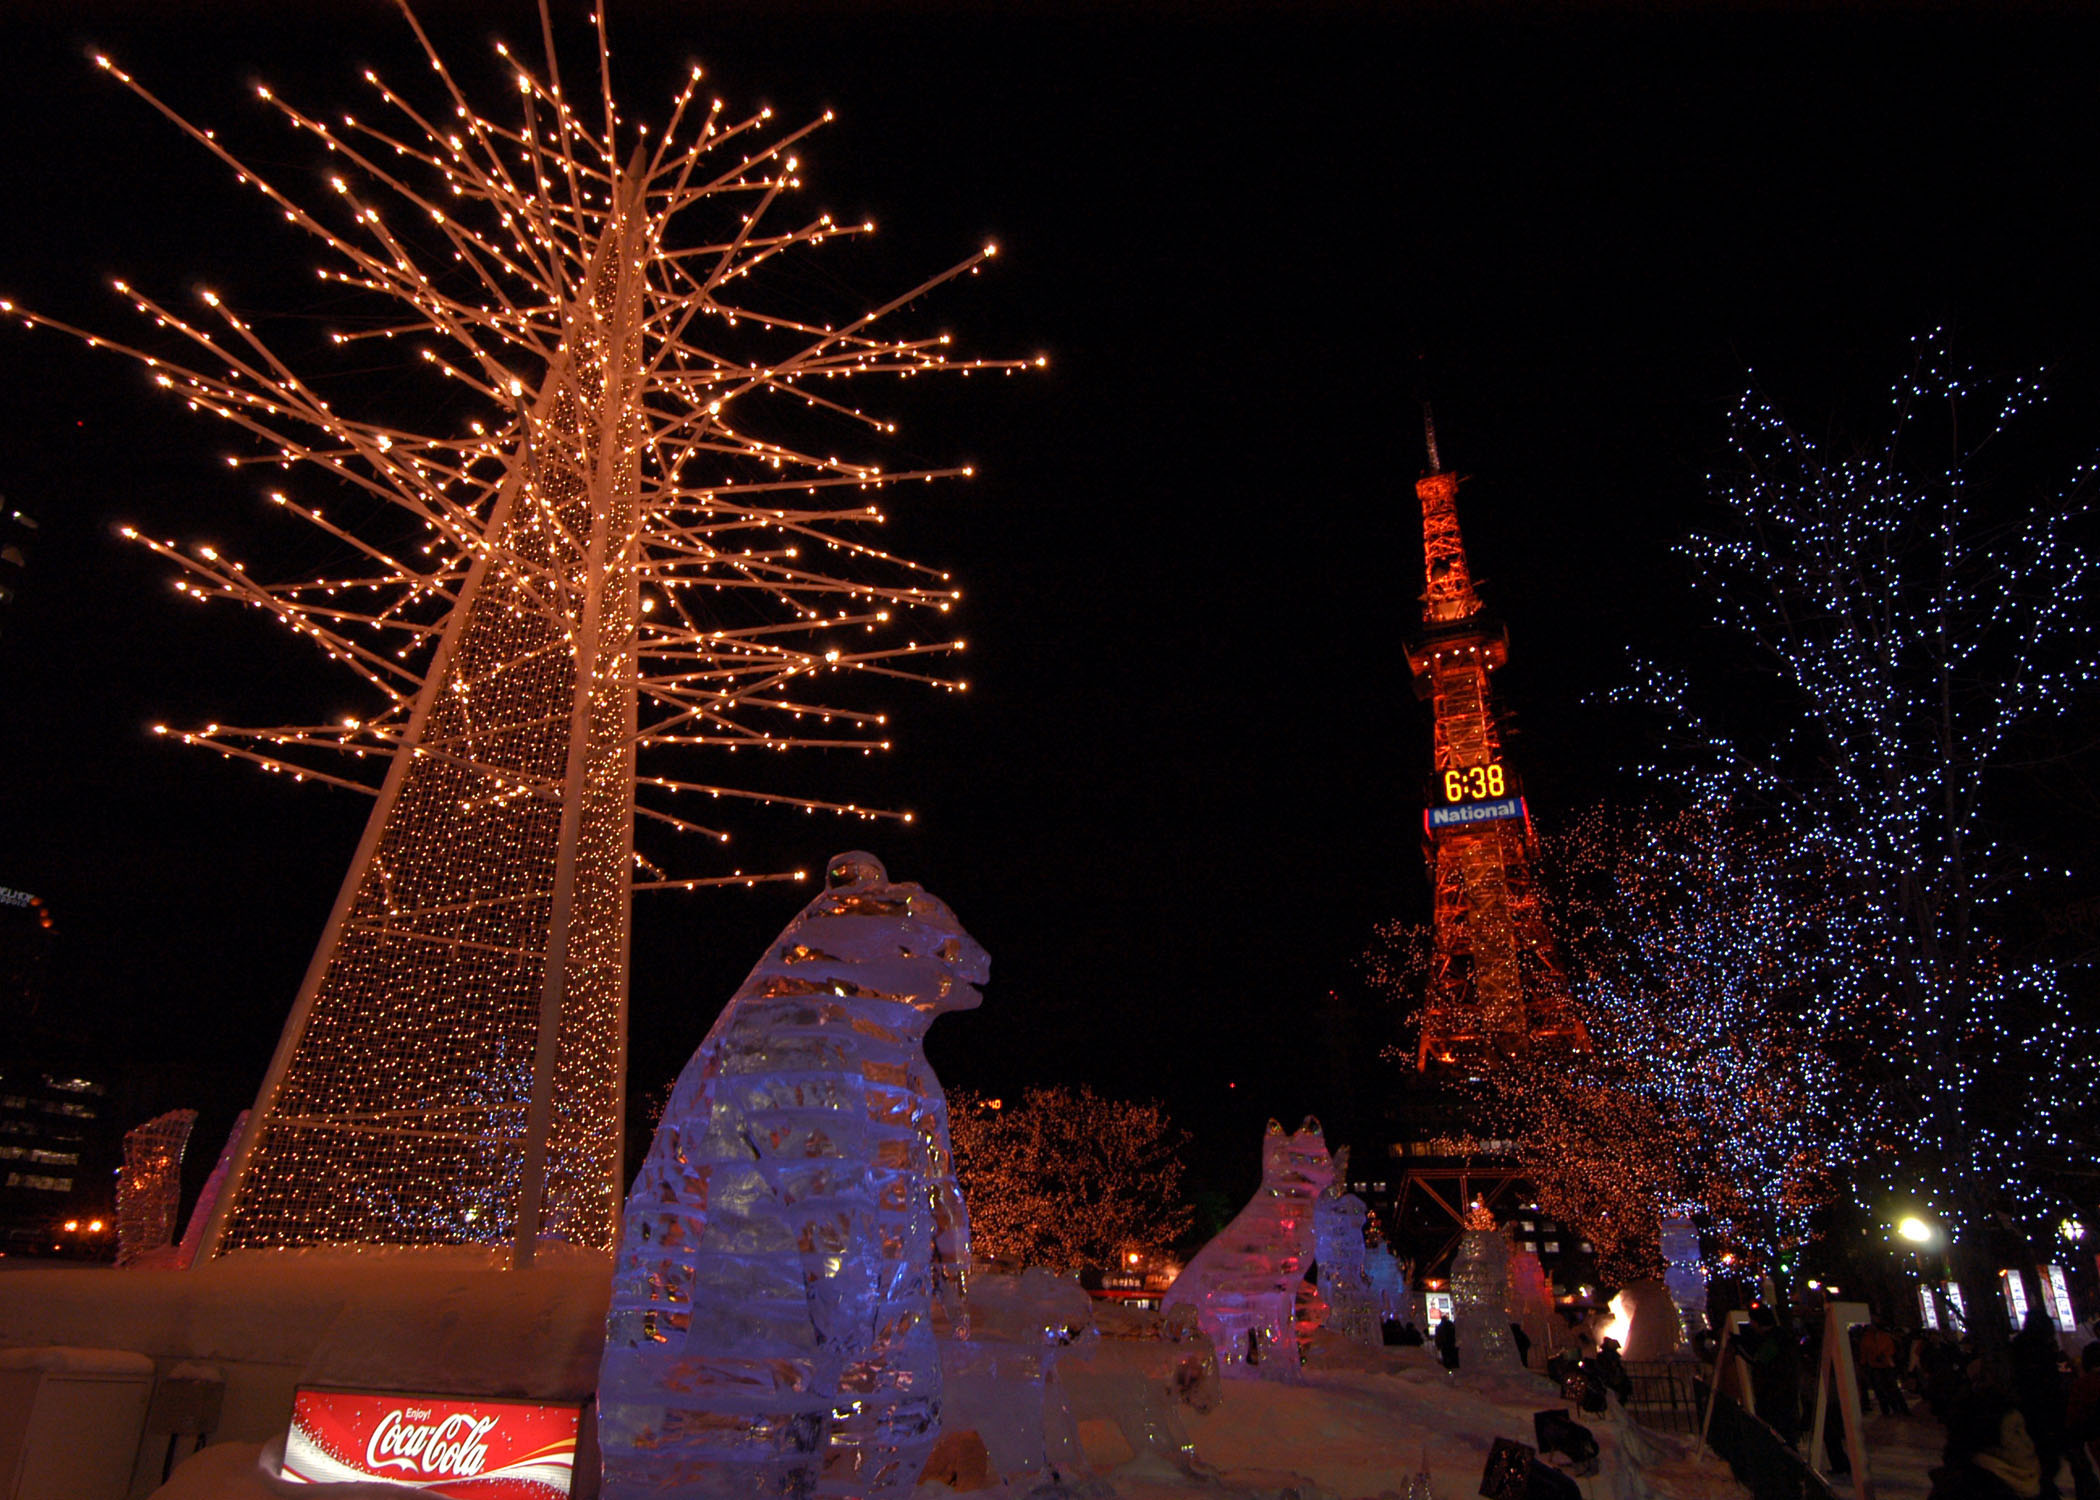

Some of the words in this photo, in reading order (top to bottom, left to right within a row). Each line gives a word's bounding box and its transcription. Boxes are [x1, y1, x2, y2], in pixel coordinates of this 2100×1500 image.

[1445, 764, 1505, 801] 6:38
[1433, 800, 1516, 824] National
[405, 1407, 432, 1421] Enjoy!
